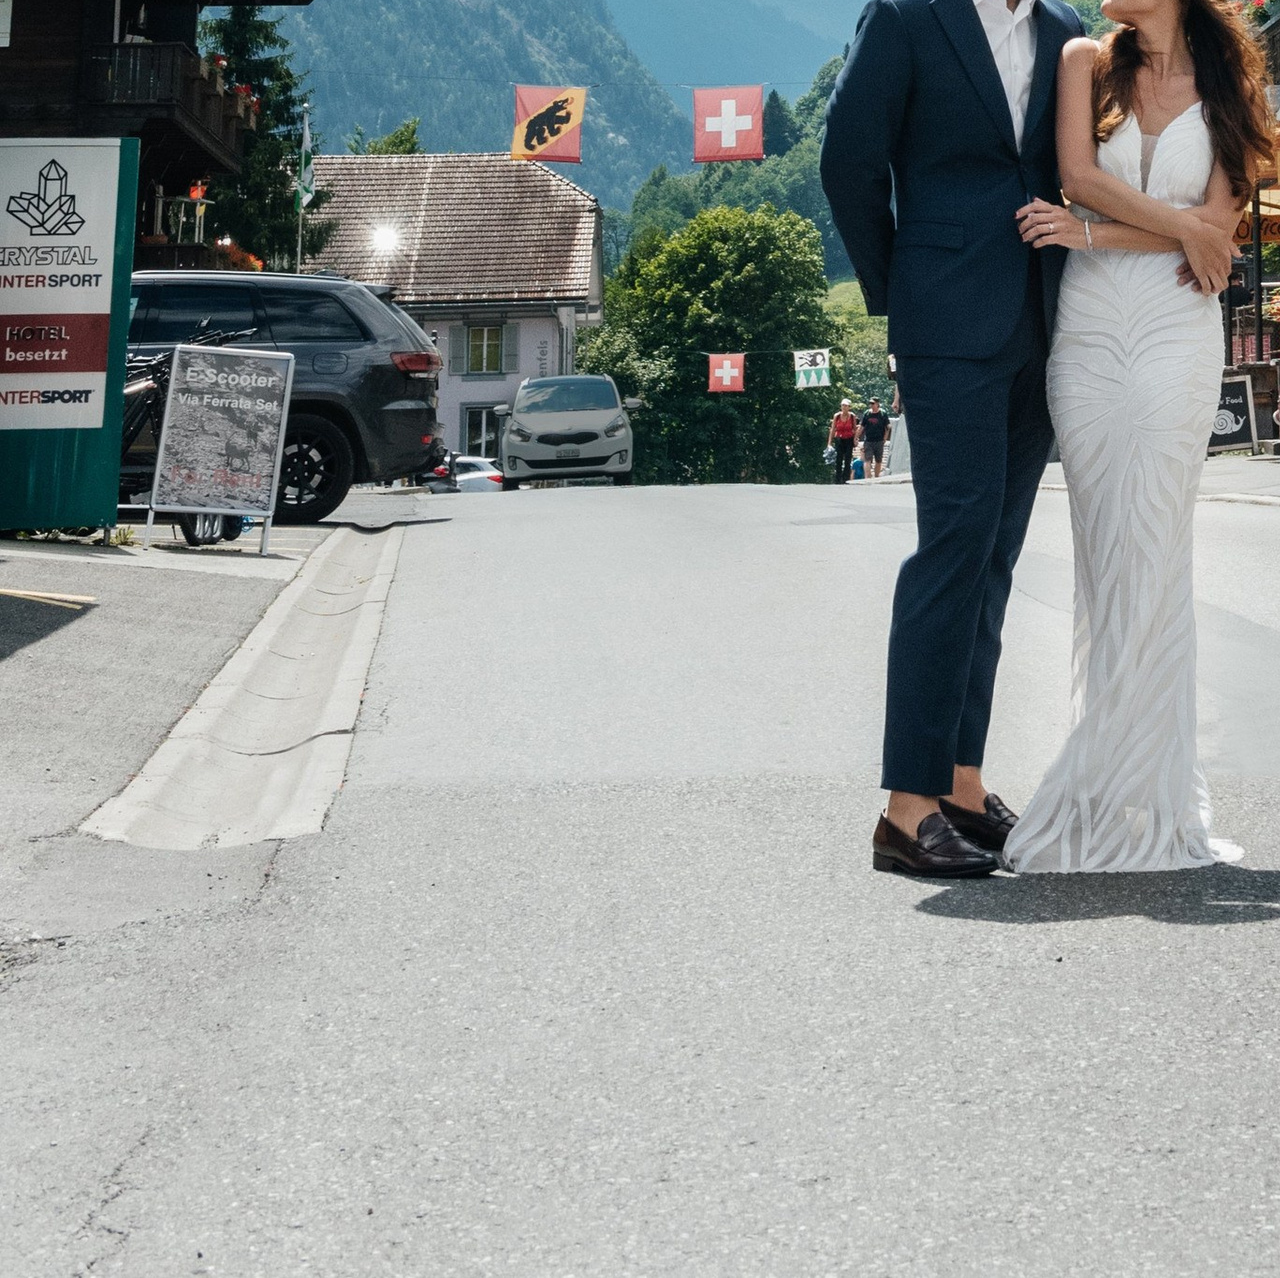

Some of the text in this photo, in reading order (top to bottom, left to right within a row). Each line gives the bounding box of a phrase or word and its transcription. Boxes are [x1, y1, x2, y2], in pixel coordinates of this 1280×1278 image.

[6, 326, 70, 341] HOTEL
[5, 347, 69, 362] besetzt
[186, 366, 277, 388] E-Scooter
[178, 392, 280, 412] Via Ferrata Set
[1226, 395, 1243, 405] Food
